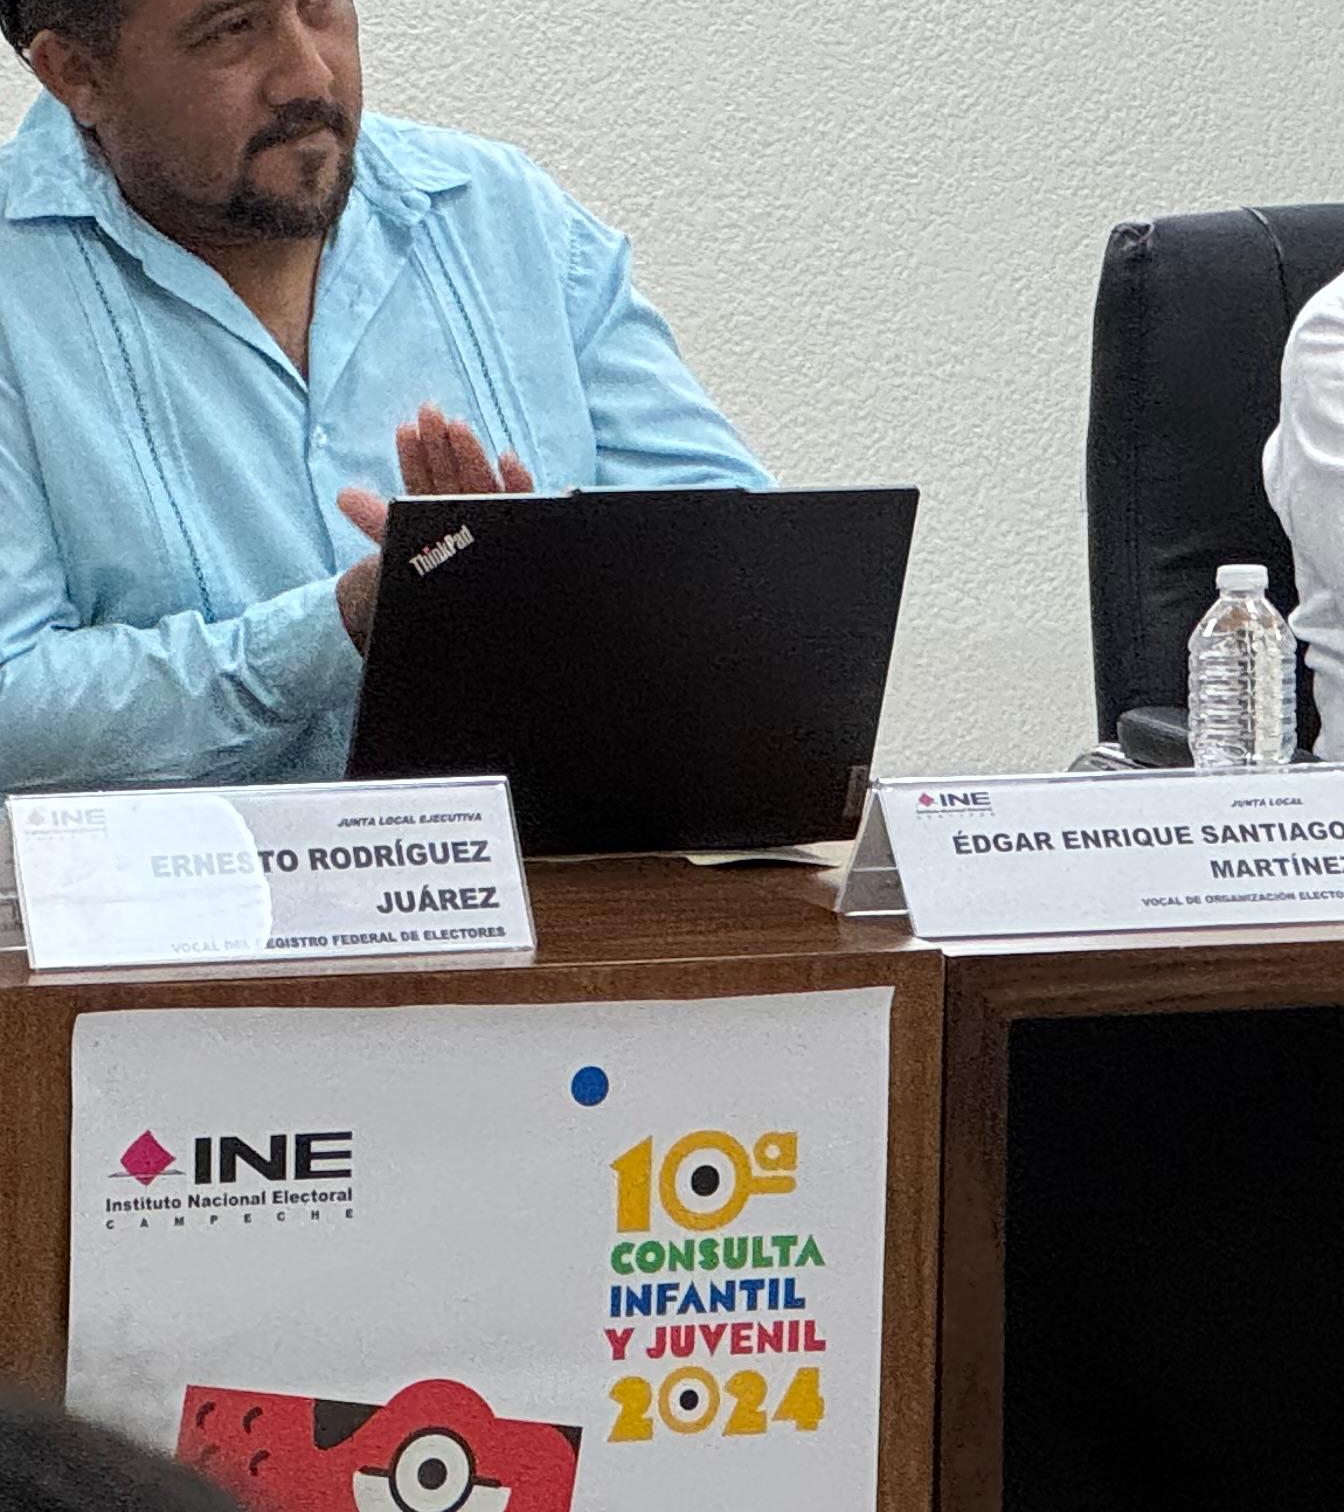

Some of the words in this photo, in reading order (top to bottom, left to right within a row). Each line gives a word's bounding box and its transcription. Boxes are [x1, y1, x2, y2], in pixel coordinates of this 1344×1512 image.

[409, 523, 475, 578] ThinkPad
[939, 791, 992, 807] INE
[1231, 799, 1267, 808] JUNTA
[1269, 797, 1304, 807] LOCAL
[337, 816, 376, 828] JUNTA
[379, 815, 416, 826] LOCAL
[419, 812, 483, 824] EJECUTIVA
[953, 830, 1055, 855] ÉDGAR
[1062, 825, 1194, 850] ENRIQUE
[150, 849, 299, 879] ERNESTO
[308, 838, 492, 871] RODRÍGUEZ
[376, 884, 500, 914] JUÁREZ
[1141, 896, 1183, 908] VOCAL
[1186, 895, 1202, 905] DE
[256, 933, 328, 950] EGISTRO
[331, 930, 394, 946] FEDERAL
[401, 929, 420, 943] DE
[423, 925, 506, 941] ELECTORES
[194, 1131, 353, 1184] INE
[106, 1197, 182, 1213] Instituto
[188, 1191, 267, 1209] Nacional
[272, 1187, 353, 1204] Electoral
[610, 1234, 827, 1276] CONSULTA
[609, 1277, 806, 1317] INFANTIL
[604, 1326, 635, 1361] Y
[646, 1319, 827, 1359] JUVENIL
[607, 1365, 826, 1443] 2024
